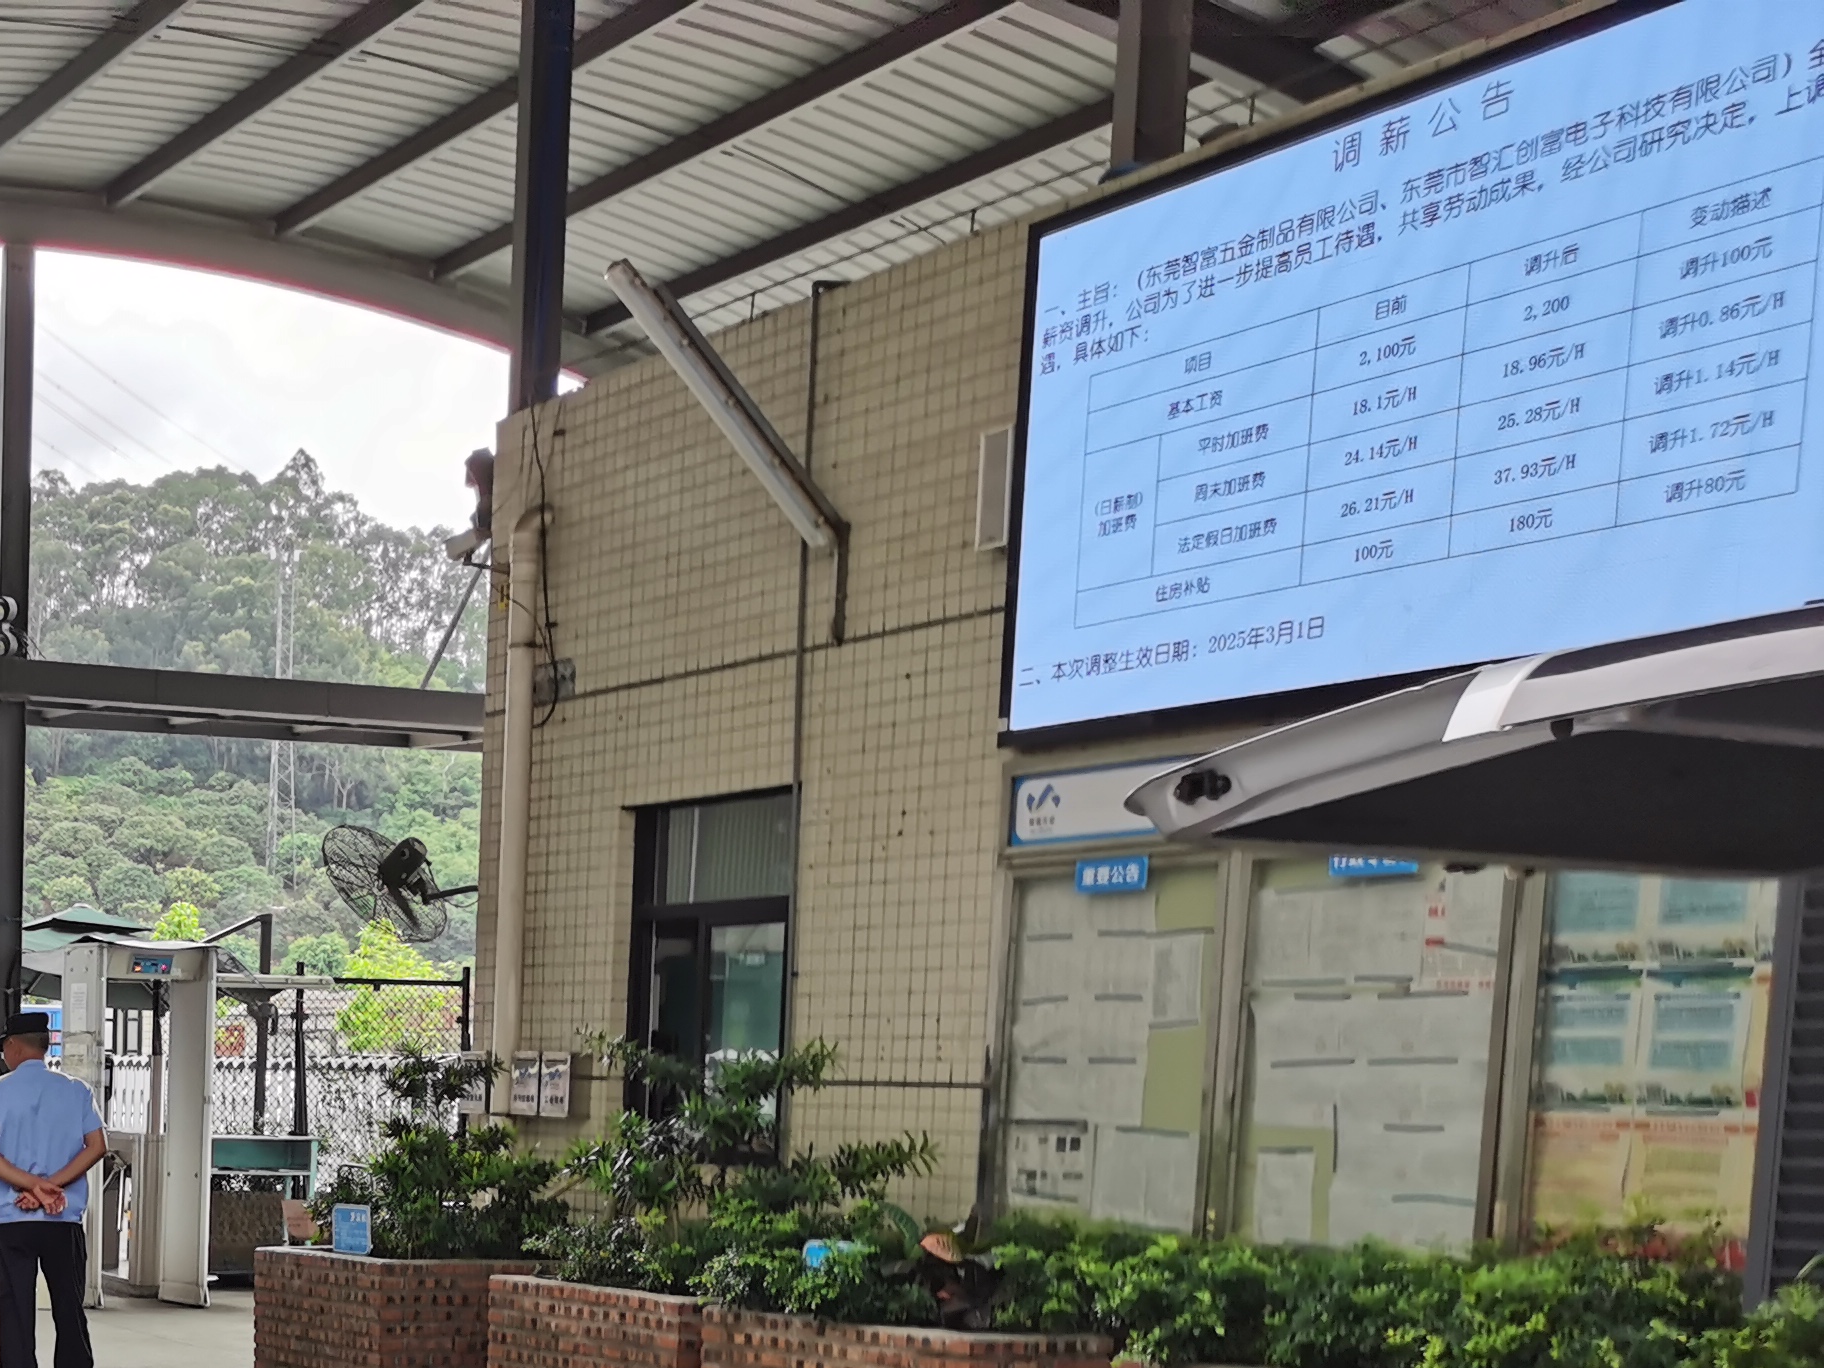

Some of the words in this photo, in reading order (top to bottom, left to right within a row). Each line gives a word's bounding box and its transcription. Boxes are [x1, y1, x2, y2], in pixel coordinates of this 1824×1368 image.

[1332, 79, 1514, 172] 调薪公告
[1689, 187, 1773, 229] 变动描述
[1523, 243, 1579, 276] 调升后
[1679, 235, 1773, 280] 调升100元
[1375, 295, 1408, 321] 目前
[1658, 290, 1786, 340] 调升0.86元/H
[1184, 350, 1212, 374] 项目
[1502, 342, 1587, 378] 18.96元/H
[1654, 349, 1781, 395] 调升1.14元/H
[1167, 390, 1223, 420] 基本工资
[1352, 386, 1417, 416] 18.1元/H
[1497, 396, 1582, 431] 25.28元/H
[1197, 423, 1270, 453] 平时加班费
[1648, 410, 1776, 454] 调升1.72元/H
[1344, 436, 1418, 466] 24.14元/H
[1494, 453, 1577, 485] 37.93元/H
[1194, 471, 1266, 503] 周末加班费
[1664, 469, 1746, 503] 调升80元
[1340, 488, 1414, 518] 26.21元/H
[1098, 513, 1138, 538] 加班费
[1177, 517, 1278, 554] 法定假日加班费
[1509, 508, 1553, 532] 180元
[1354, 538, 1394, 562] 100元
[1155, 576, 1211, 603] 住房补贴
